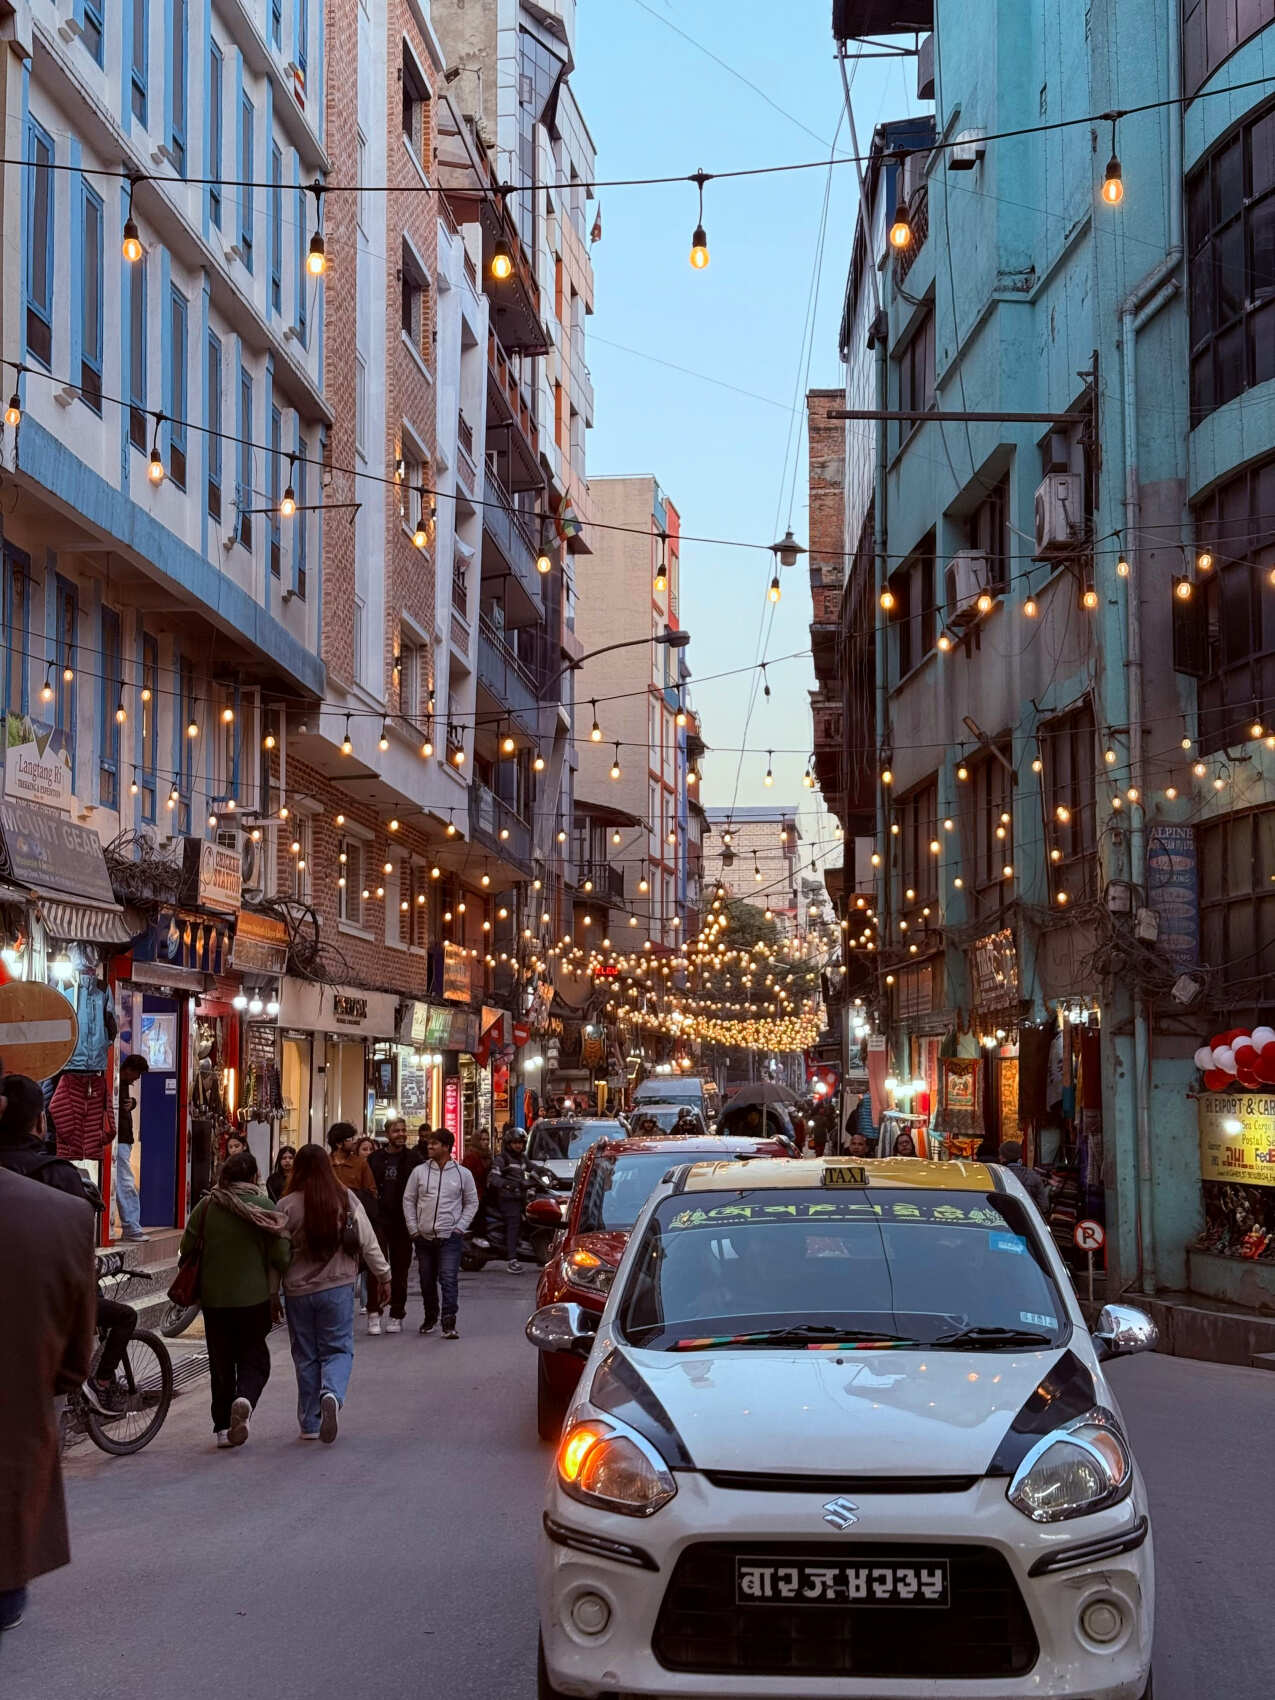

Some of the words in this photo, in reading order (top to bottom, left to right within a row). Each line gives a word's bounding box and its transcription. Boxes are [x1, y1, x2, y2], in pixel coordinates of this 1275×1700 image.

[18, 754, 53, 787] Langtang
[54, 765, 62, 784] Ri
[1, 804, 59, 845] MOUNT
[62, 825, 103, 858] GEAR
[1151, 827, 1194, 839] ALPINE
[213, 868, 241, 895] STATION
[1214, 1098, 1244, 1114] EXPORT
[1246, 1097, 1255, 1115] &
[1241, 1134, 1263, 1146] Postal
[825, 1167, 864, 1184] TAXI
[1083, 1227, 1095, 1244] P
